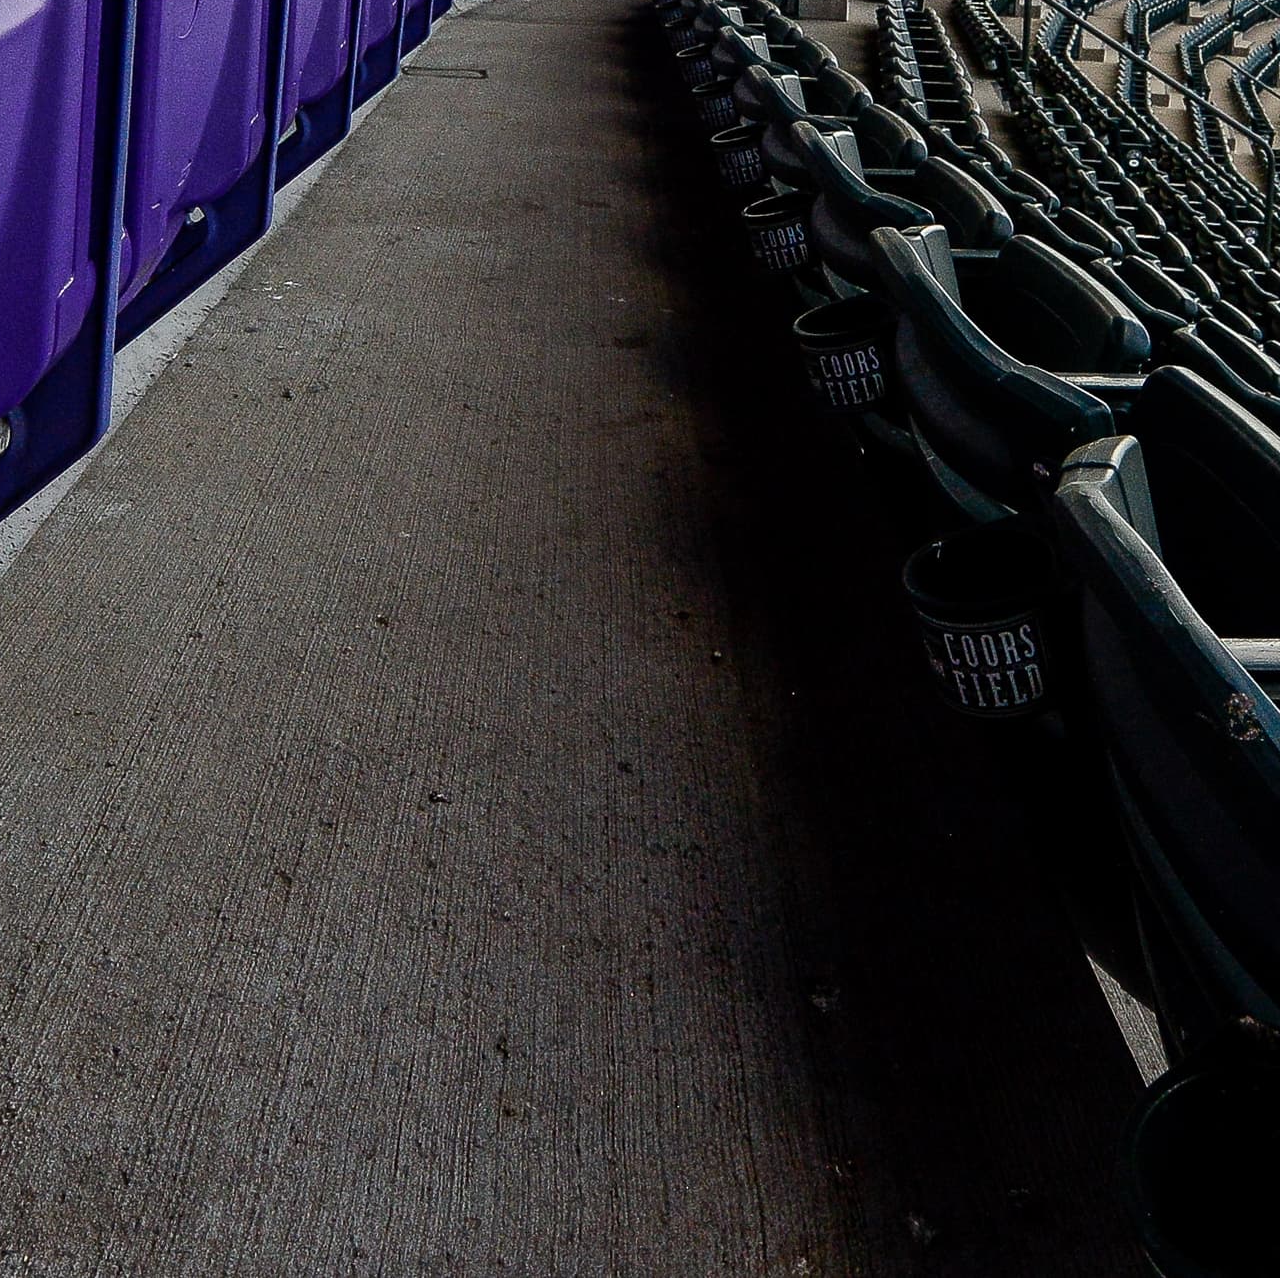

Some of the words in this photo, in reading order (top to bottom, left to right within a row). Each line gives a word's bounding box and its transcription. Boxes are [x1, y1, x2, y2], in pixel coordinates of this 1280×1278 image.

[759, 222, 805, 249] COORS
[764, 243, 809, 270] FIELD
[819, 345, 880, 379] COORS
[825, 372, 886, 406] FIELD
[942, 623, 1037, 668] COORS
[952, 663, 1045, 708] FIELD
